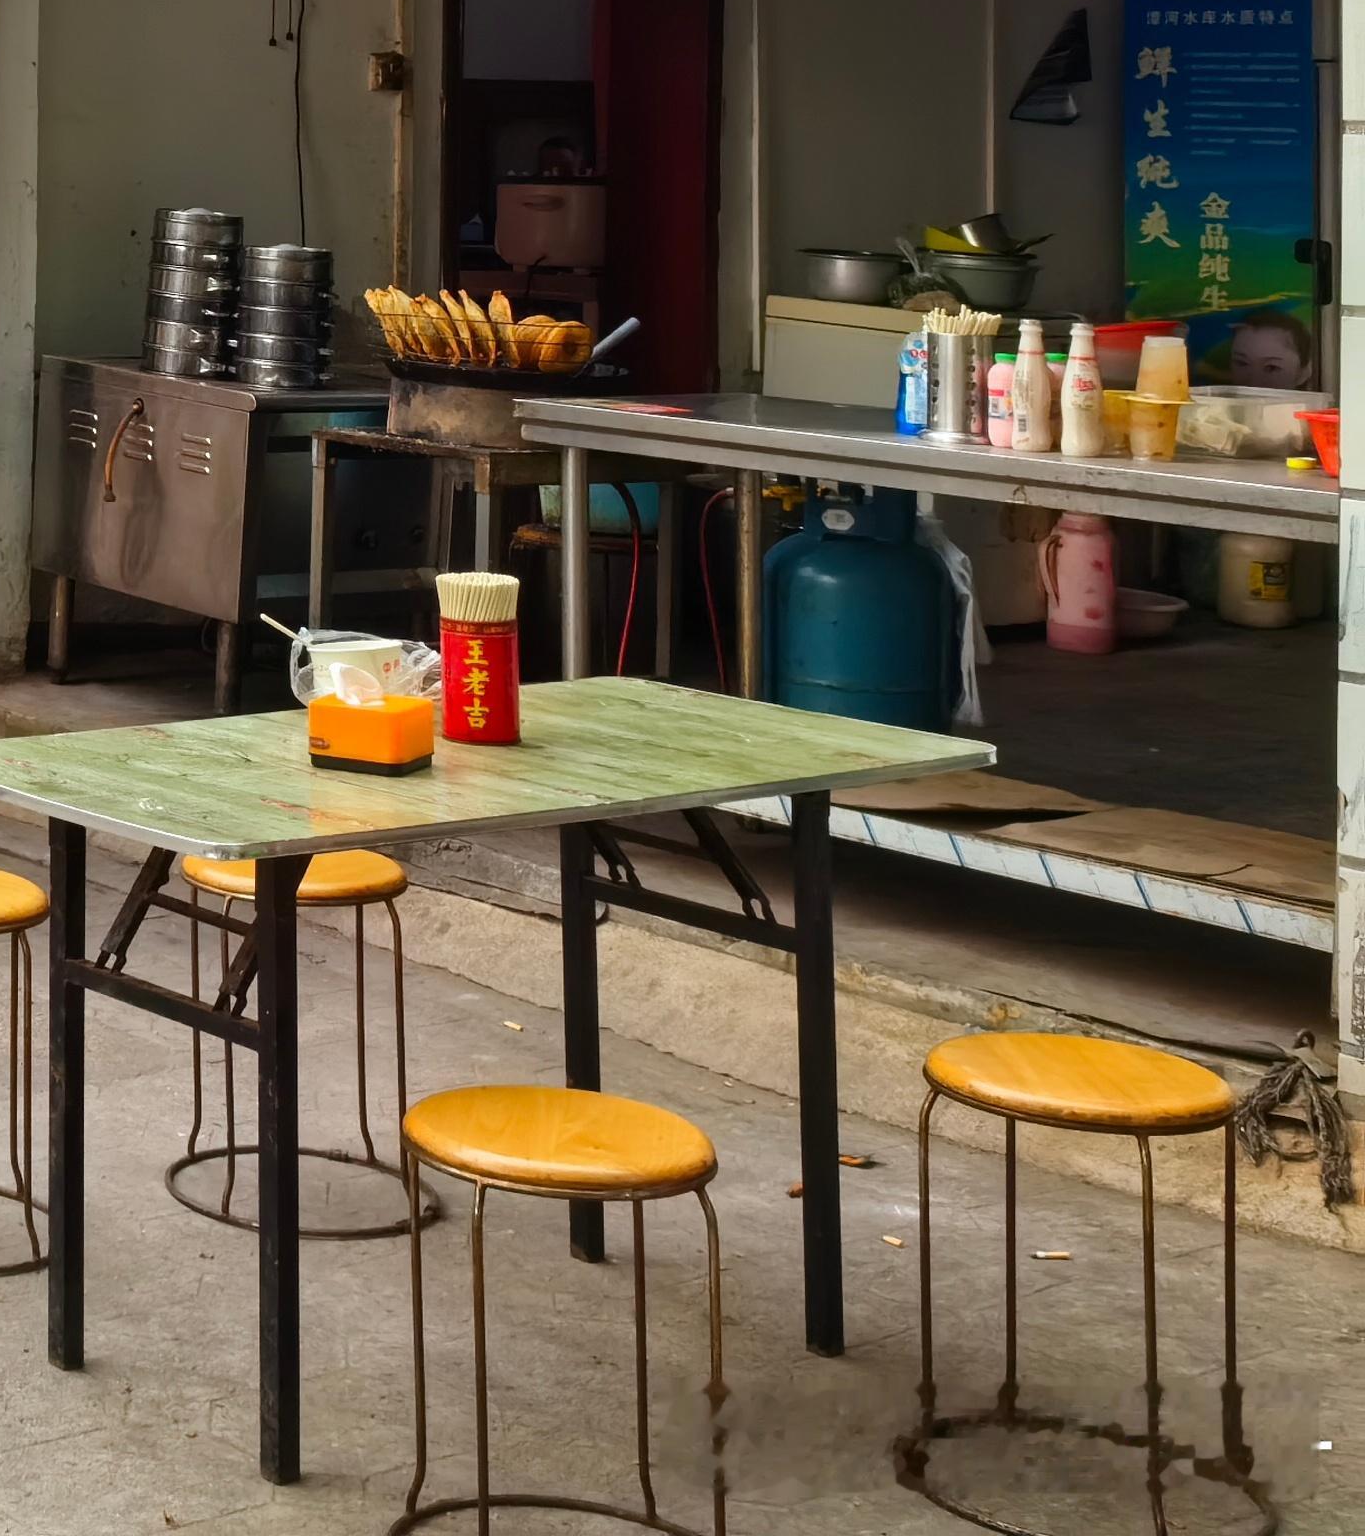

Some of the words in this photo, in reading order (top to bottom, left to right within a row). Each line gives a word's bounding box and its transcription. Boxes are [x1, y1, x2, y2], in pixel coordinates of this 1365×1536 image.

[1198, 191, 1232, 312] 金品纯生
[462, 639, 491, 730] 王老吉
